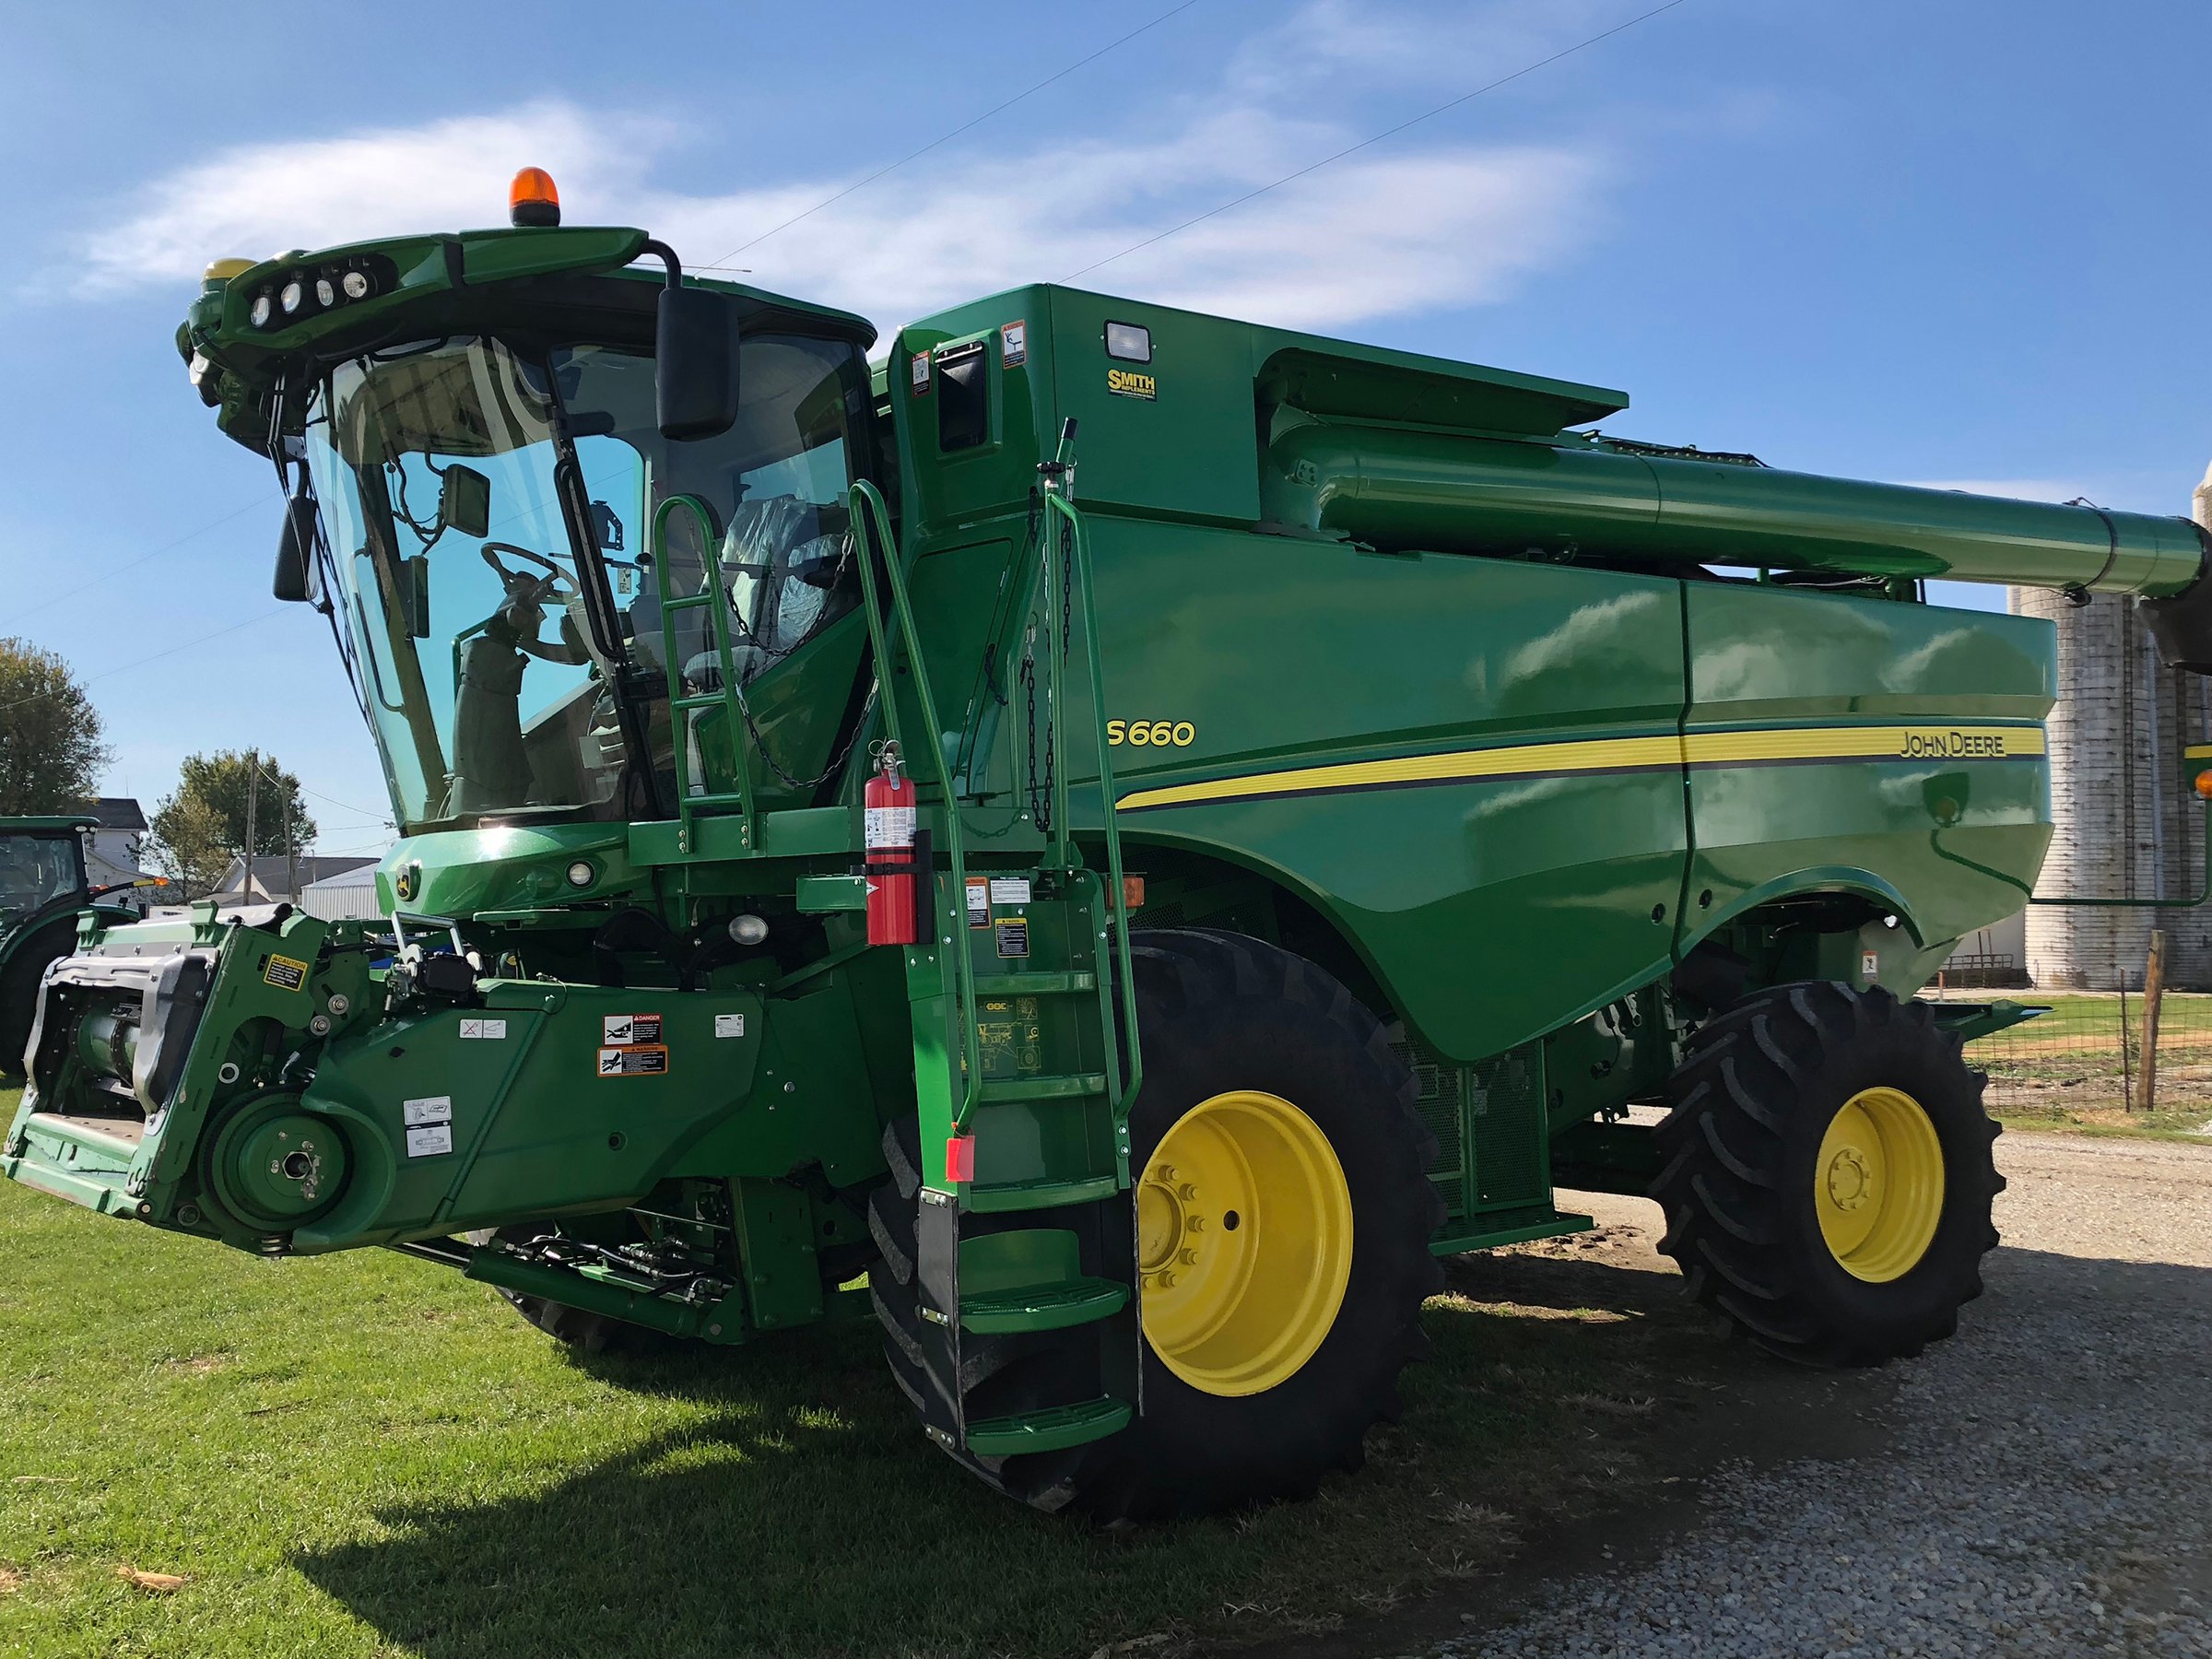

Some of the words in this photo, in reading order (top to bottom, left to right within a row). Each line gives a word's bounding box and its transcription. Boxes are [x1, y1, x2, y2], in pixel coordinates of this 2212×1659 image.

[1108, 369, 1155, 390] SMITH
[1107, 719, 1195, 747] S660
[1900, 731, 1947, 755] JOHN
[1949, 731, 2005, 755] DEERE
[277, 958, 307, 970] CAUTION
